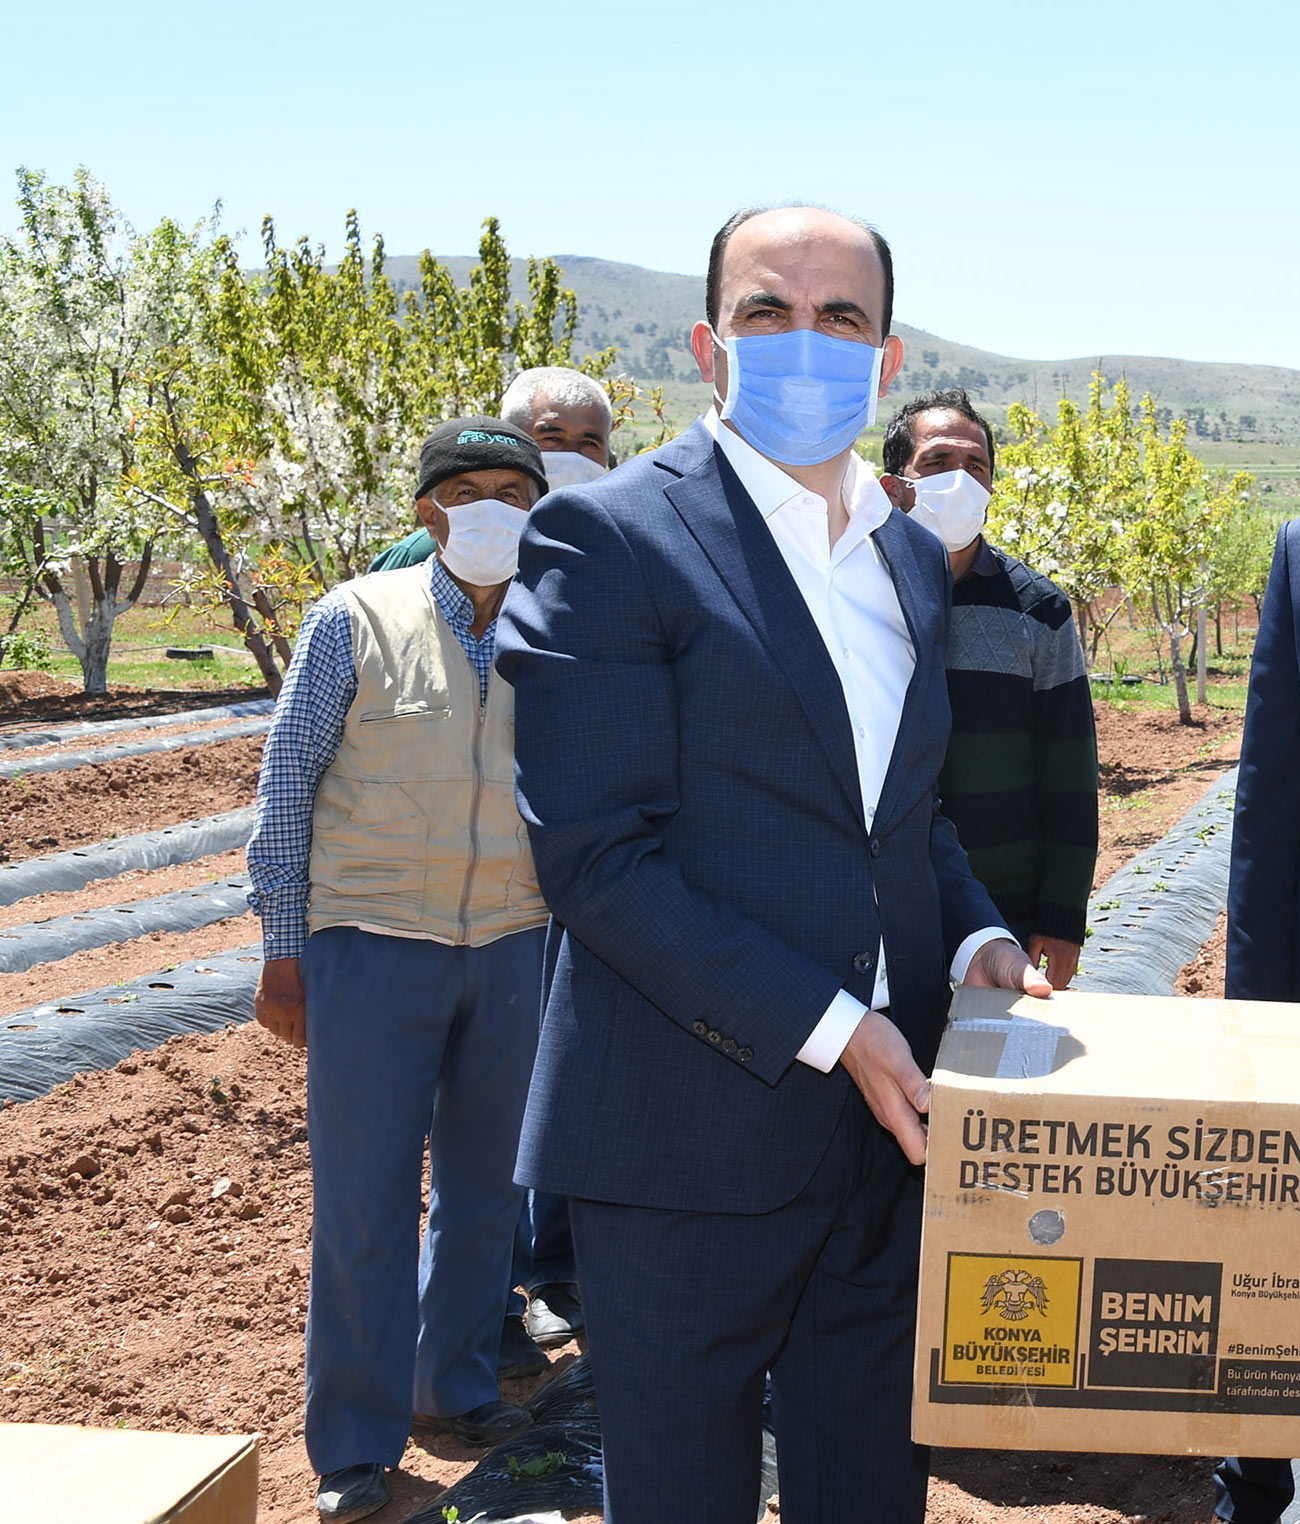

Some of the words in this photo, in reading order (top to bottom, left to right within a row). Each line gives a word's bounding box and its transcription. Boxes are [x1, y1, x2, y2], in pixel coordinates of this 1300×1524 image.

[962, 1109, 1152, 1159] ÜRETMEK
[960, 1160, 1083, 1194] DESTEK
[1233, 1274, 1268, 1290] Uğur
[1231, 1289, 1256, 1300] Konya
[984, 1327, 1042, 1342] KONYA
[953, 1341, 1071, 1364] BÜYÜKŞEHİR
[976, 1364, 1046, 1377] BELEDİYESİ
[1227, 1369, 1241, 1379] Bu
[1244, 1369, 1268, 1381] ürün
[1226, 1386, 1280, 1397] tarafından
